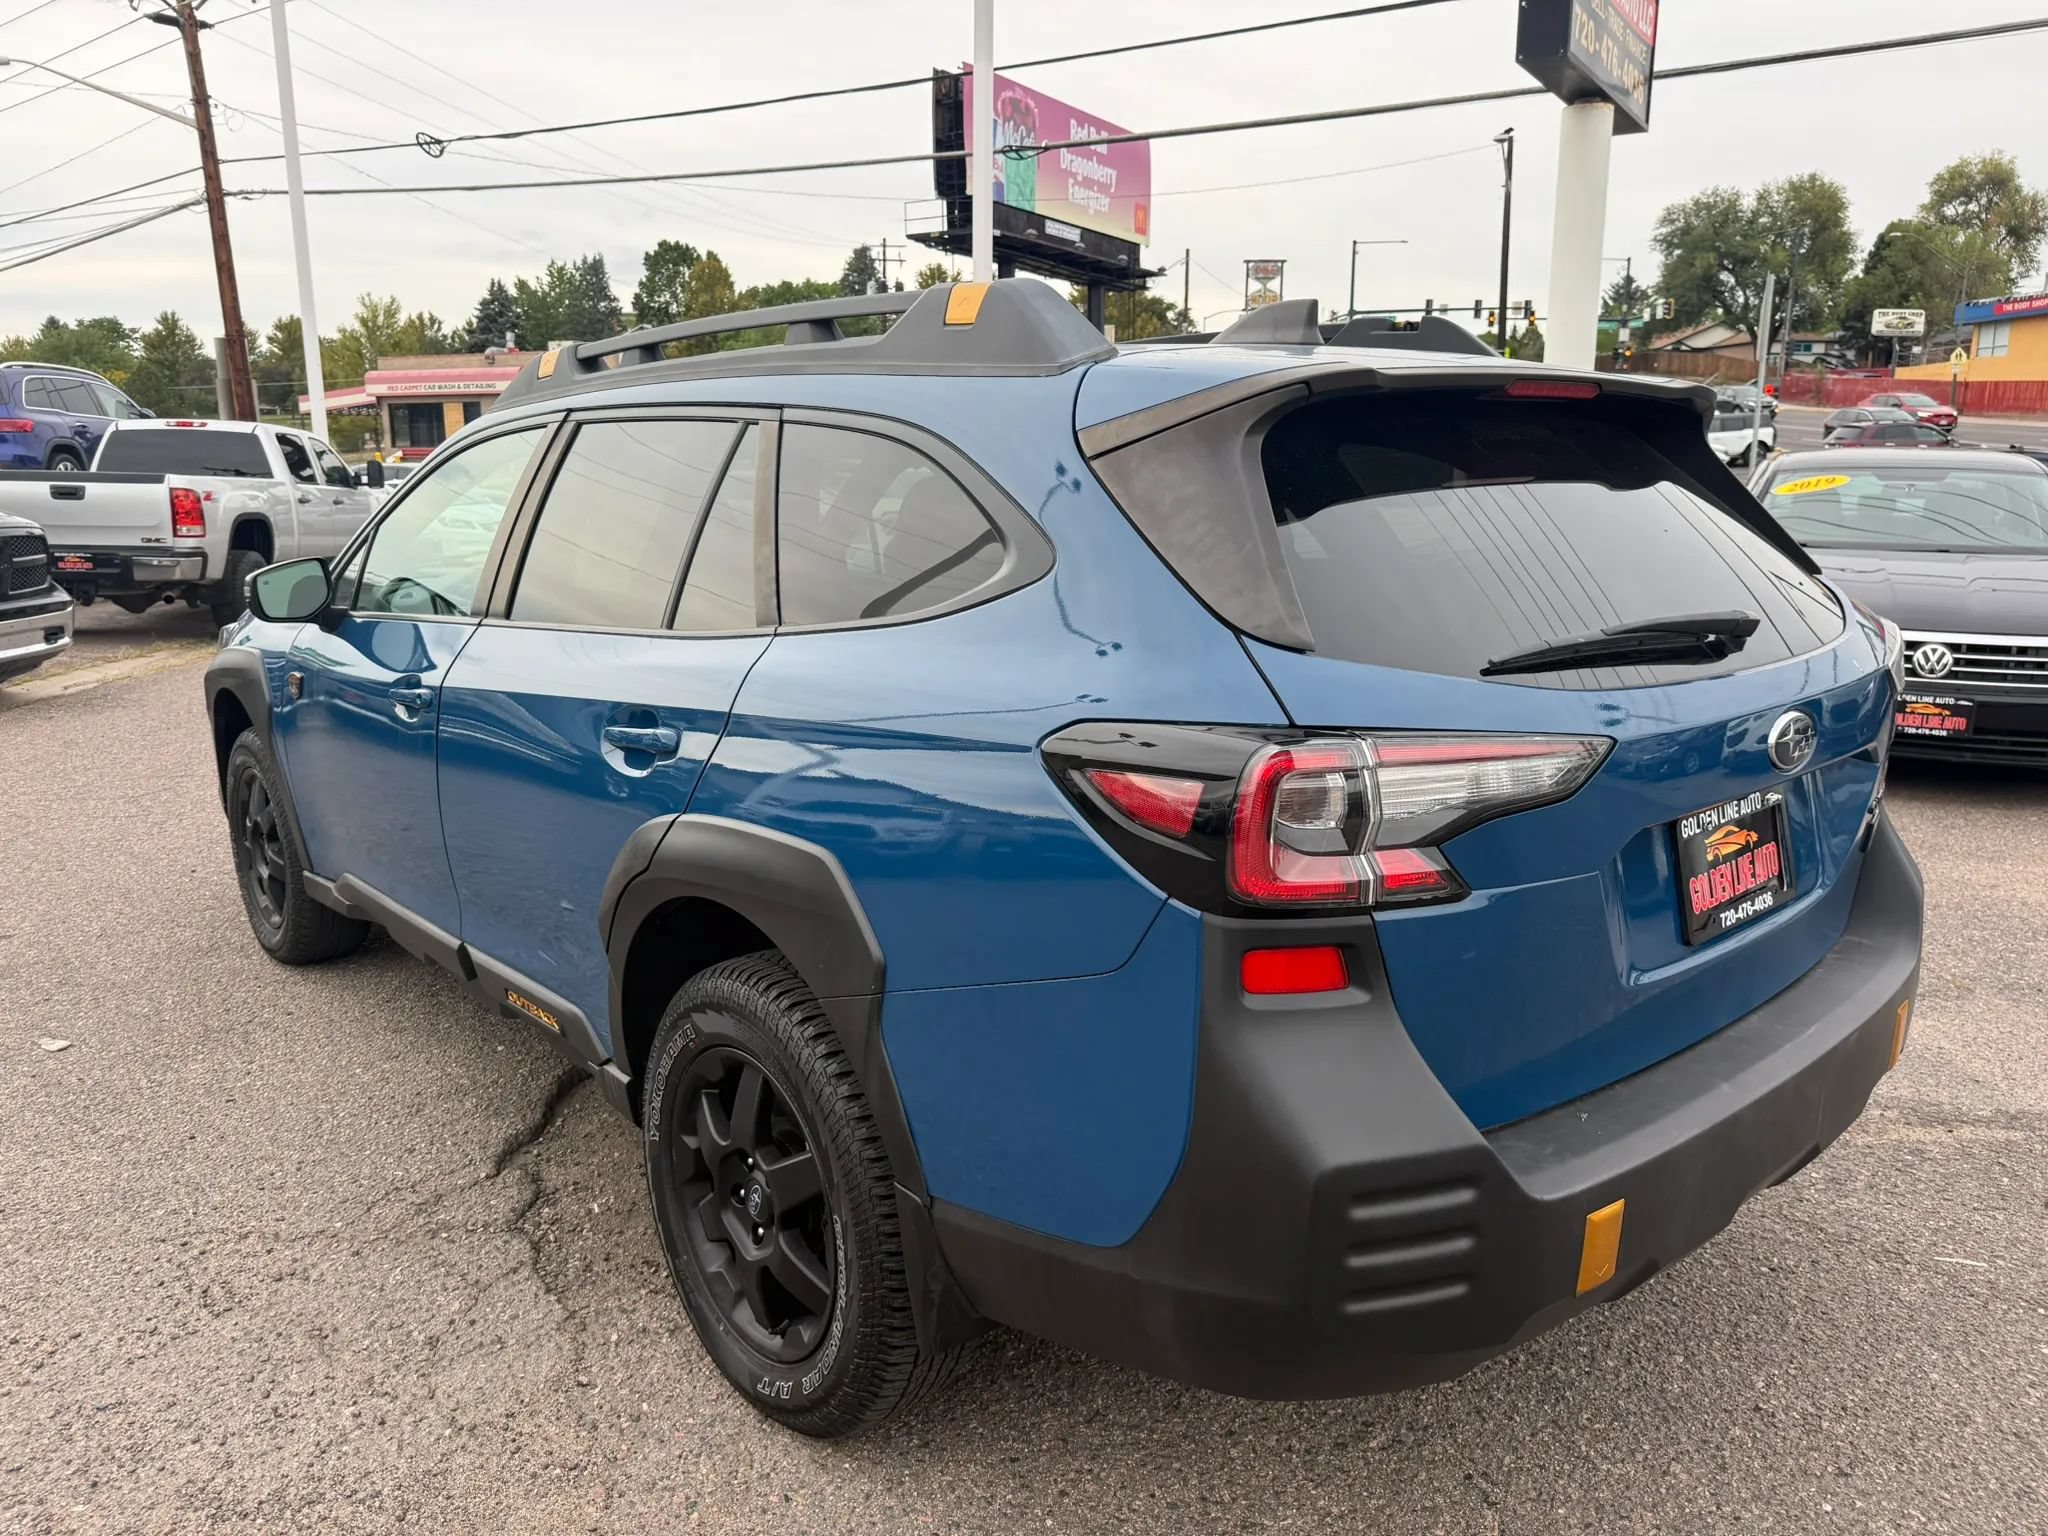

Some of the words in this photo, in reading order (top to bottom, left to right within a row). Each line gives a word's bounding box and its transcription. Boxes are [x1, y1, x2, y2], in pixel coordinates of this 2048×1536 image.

[1069, 118, 1089, 142] Red
[1060, 147, 1117, 193] Dragonberry
[1068, 177, 1110, 215] Energizer
[2002, 304, 2014, 312] THE
[2014, 302, 2031, 310] BODY
[2031, 298, 2048, 308] SHOP
[1789, 476, 1837, 493] 2019
[1917, 695, 1935, 704] LINE
[1935, 697, 1955, 705] AUTO
[1922, 714, 1942, 729] LINE
[1942, 716, 1967, 730] AUTO
[1681, 807, 1719, 838] GOLDEN
[1718, 801, 1740, 825] LINE
[1740, 792, 1762, 815] AUTO
[1689, 861, 1734, 914] GOLDEN
[1732, 852, 1756, 896] LINE
[1754, 841, 1780, 884] AUTO
[1720, 890, 1774, 928] 720-476-4036
[507, 990, 560, 1030] OUTBACK
[649, 1023, 696, 1141] YOKOHAMA
[802, 1215, 847, 1395] GEOLANDAR
[756, 1377, 793, 1399] A/T
